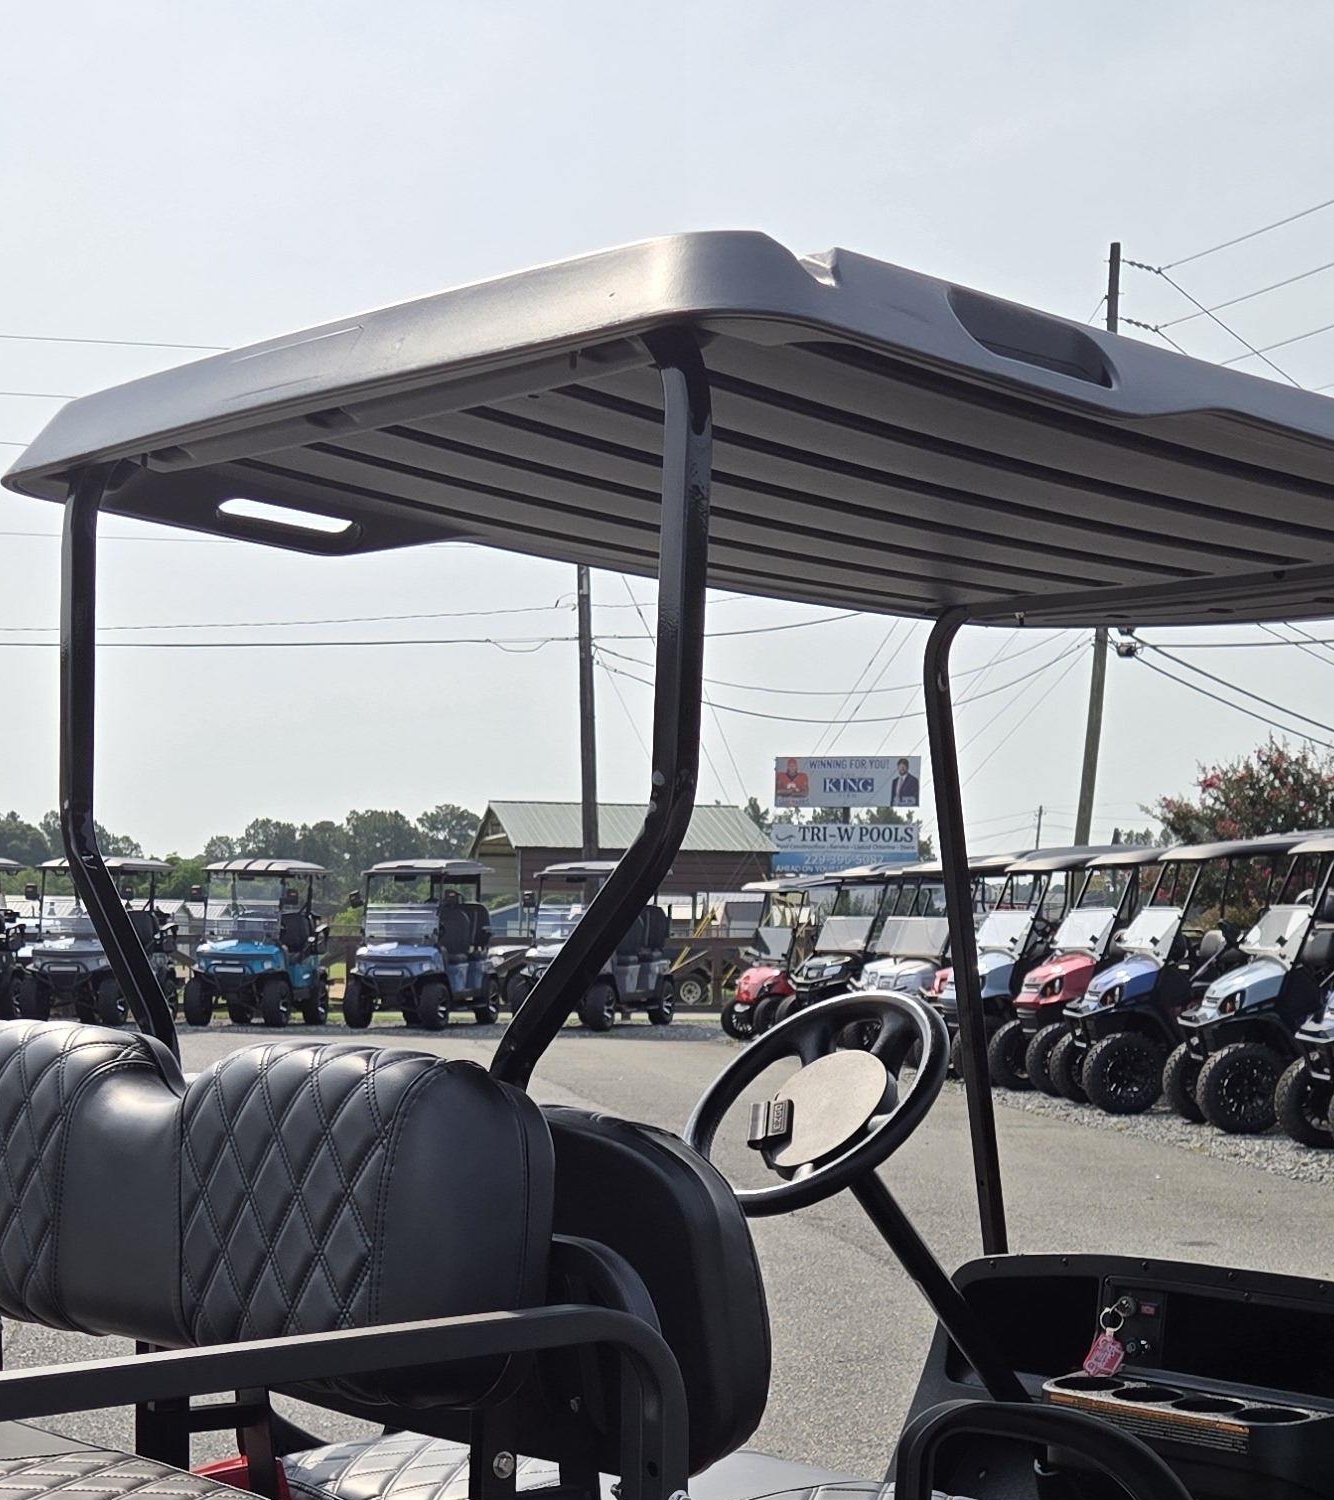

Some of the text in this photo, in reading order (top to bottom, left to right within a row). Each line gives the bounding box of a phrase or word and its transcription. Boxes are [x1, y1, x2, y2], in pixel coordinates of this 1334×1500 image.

[809, 759, 890, 769] WINNING FOR YOU!
[825, 779, 873, 793] KING
[798, 826, 914, 843] TRI-W POOLS
